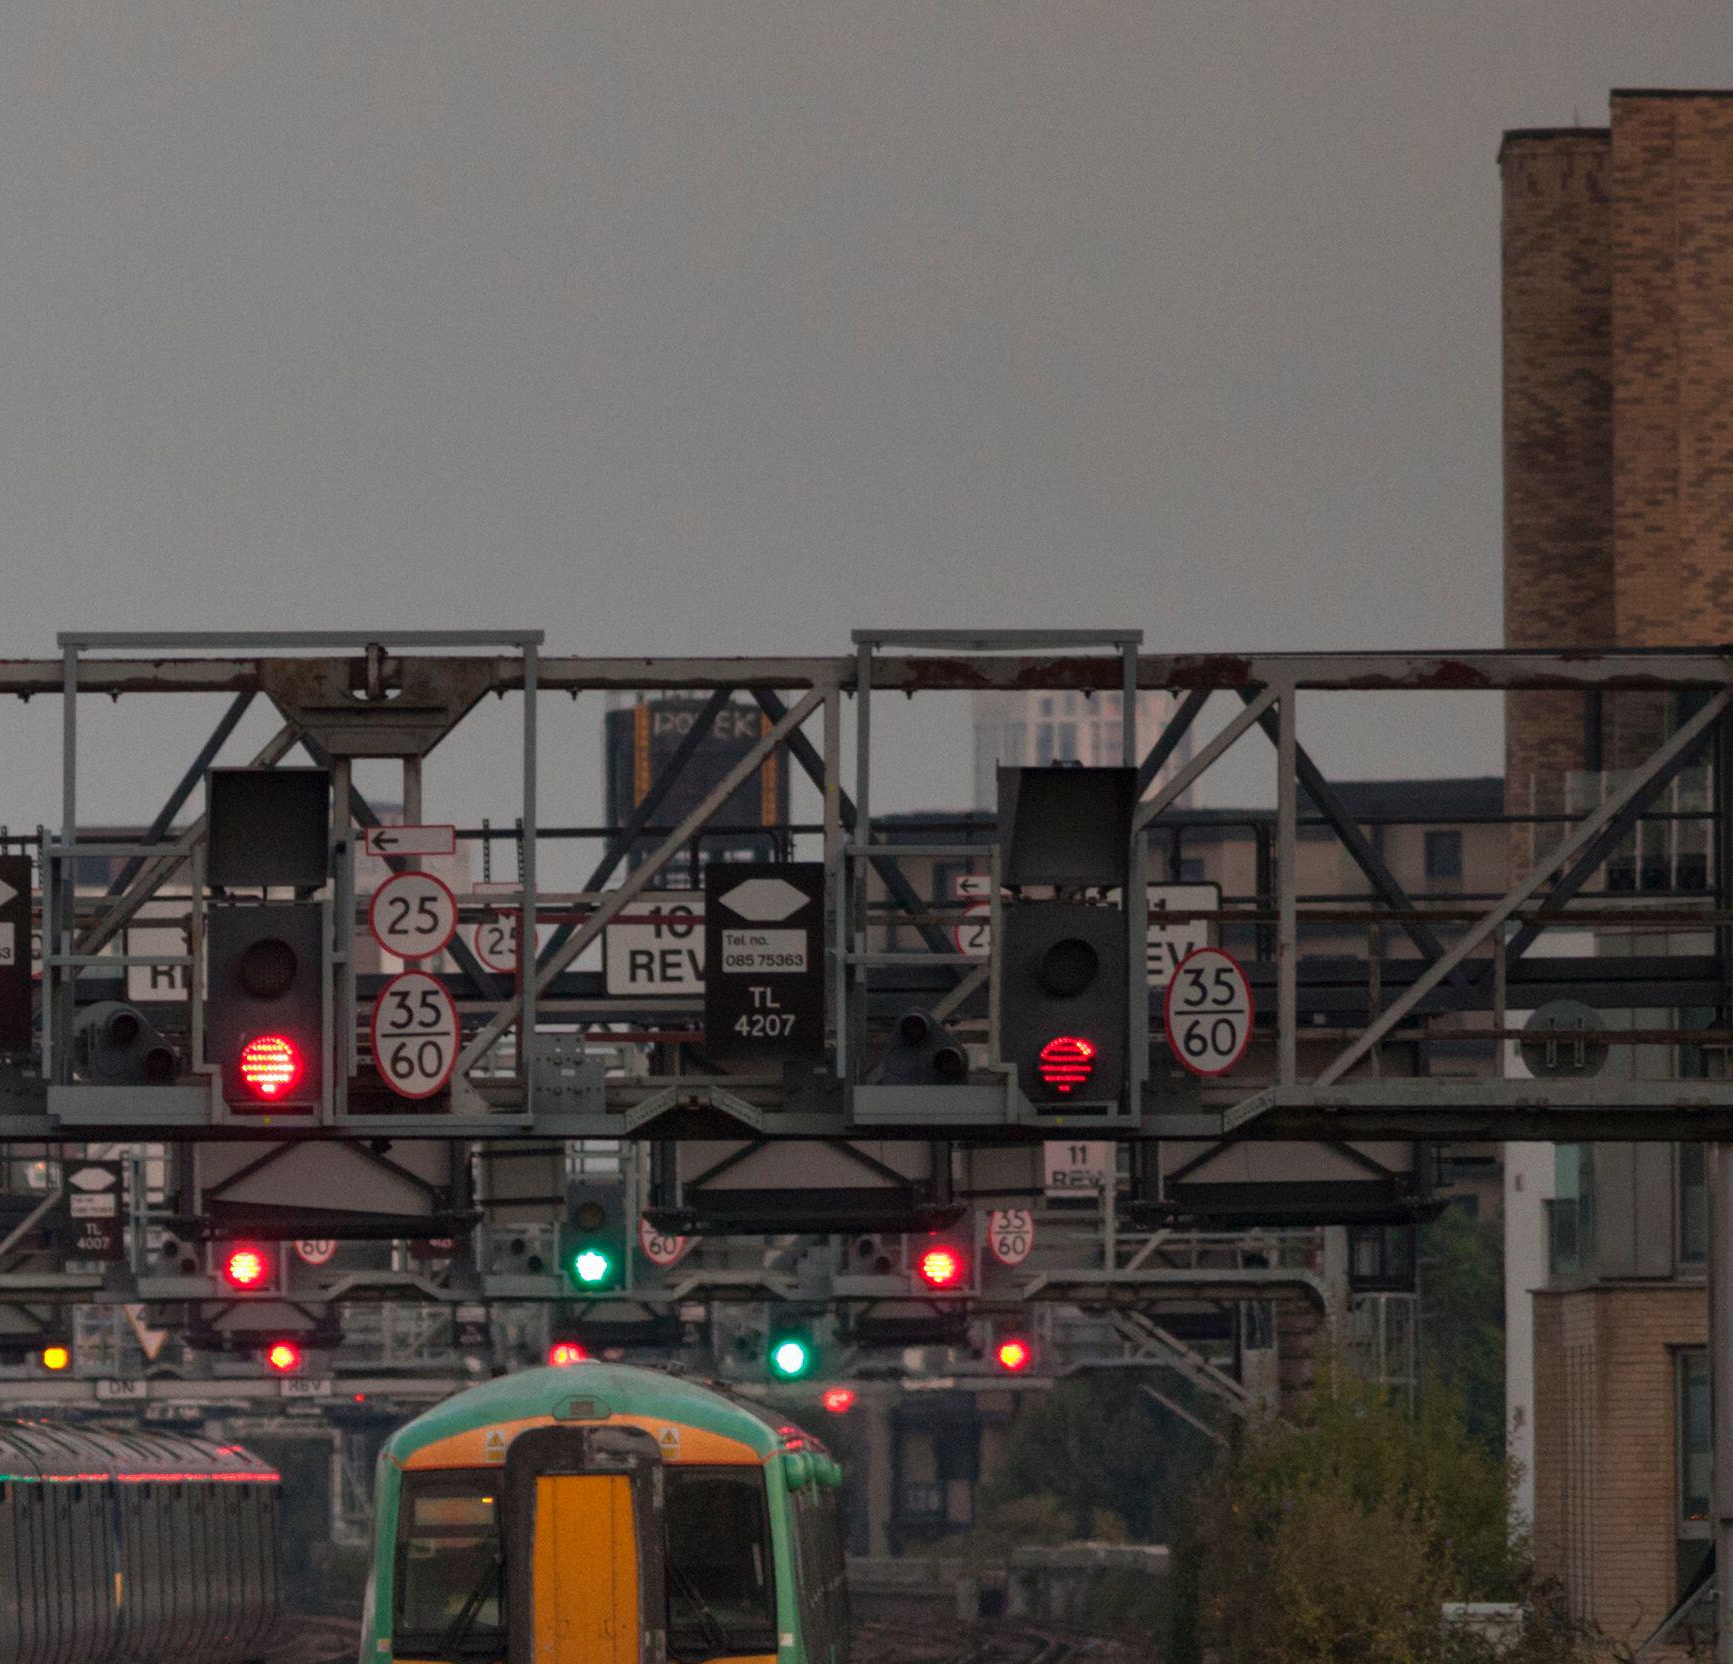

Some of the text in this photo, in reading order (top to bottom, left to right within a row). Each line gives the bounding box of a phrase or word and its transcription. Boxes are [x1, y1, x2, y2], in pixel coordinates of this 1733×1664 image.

[388, 897, 439, 935] 25
[726, 934, 768, 945] Tel. no.
[726, 954, 803, 967] 085 75363
[748, 986, 780, 1008] TL
[1184, 968, 1235, 1007] 35
[389, 990, 441, 1029] 35
[734, 1014, 796, 1037] 4207
[1184, 1018, 1236, 1057] 60
[390, 1041, 443, 1079] 60
[85, 1223, 102, 1235] TL
[998, 1235, 1026, 1255] 60
